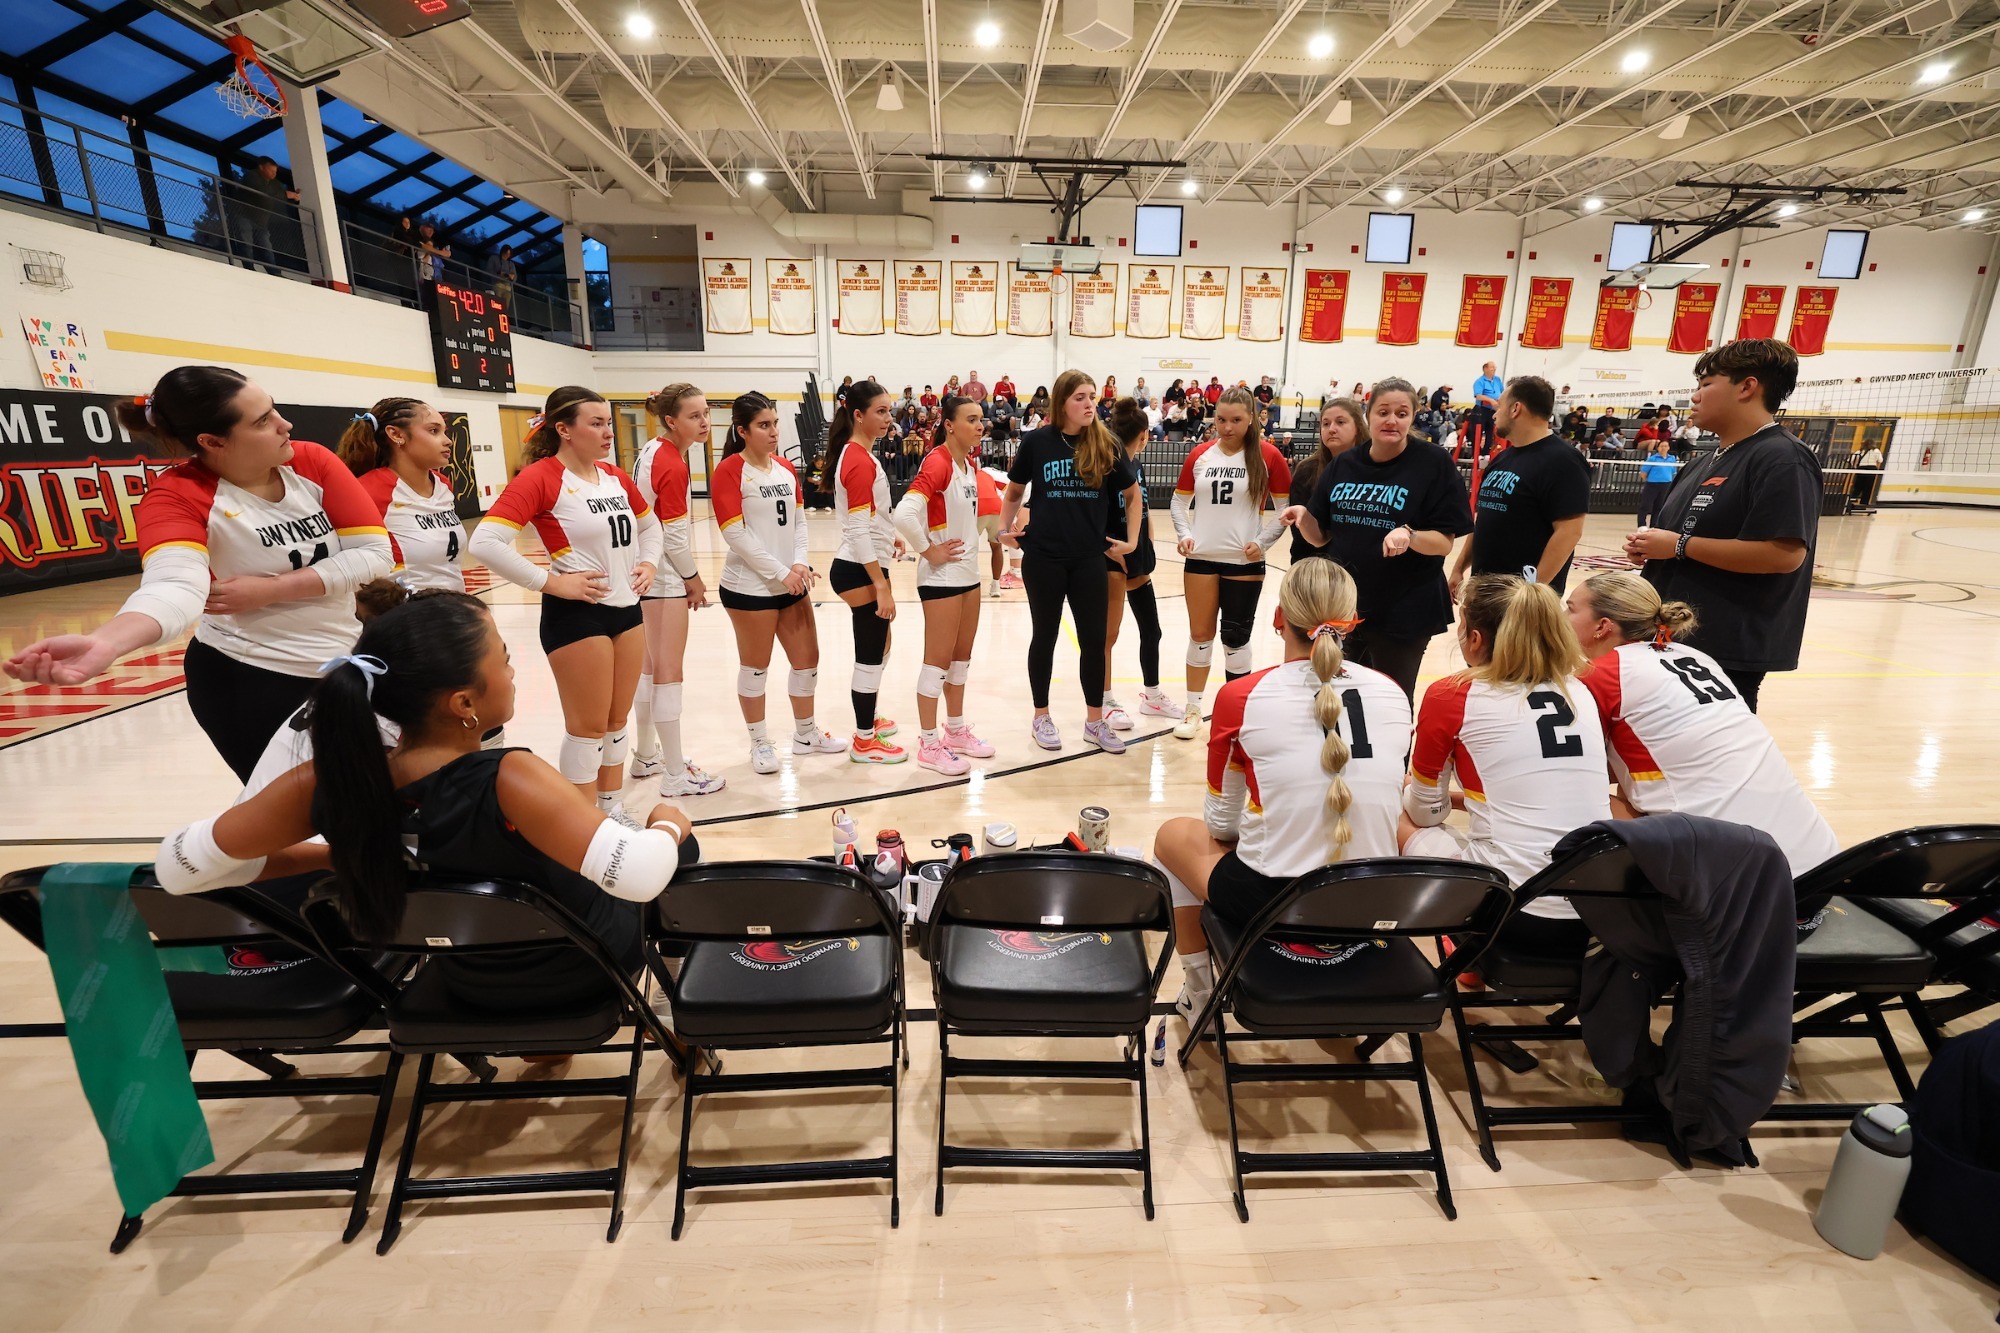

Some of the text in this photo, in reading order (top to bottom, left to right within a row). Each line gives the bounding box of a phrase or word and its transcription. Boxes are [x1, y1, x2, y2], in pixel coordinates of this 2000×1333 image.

[450, 300, 459, 322] 7
[487, 327, 495, 342] 0
[472, 343, 487, 354] player
[69, 363, 77, 373] A
[451, 353, 459, 370] 0
[481, 358, 487, 373] 2
[1158, 359, 1193, 369] Griffins
[1595, 370, 1627, 380] Visitors
[1806, 378, 1844, 387] UNIVERSITY
[1869, 367, 1988, 384] GWYNEDD MERCY UNIVERSITY
[82, 405, 132, 444] O
[1204, 466, 1246, 479] GWYNEDD
[759, 483, 793, 498] GWYNEDD
[1211, 480, 1234, 505] 12
[1329, 482, 1409, 511] GRIFFINS
[776, 499, 787, 526] 9
[1336, 501, 1390, 515] VOLLEYBALL
[607, 514, 632, 549] 10
[1344, 514, 1361, 525] THAN
[1360, 516, 1396, 530] ATHLETES
[446, 530, 459, 562] 4
[1660, 656, 1737, 705] 19
[1526, 691, 1584, 759] 2
[729, 941, 842, 971] GWYNEDD MERCY UNIVERSITY
[986, 935, 1094, 961] GWYNEDD MERCY UNIVERSITY
[1269, 945, 1318, 965] UNIVERSITY
[240, 966, 279, 977] MERCY
